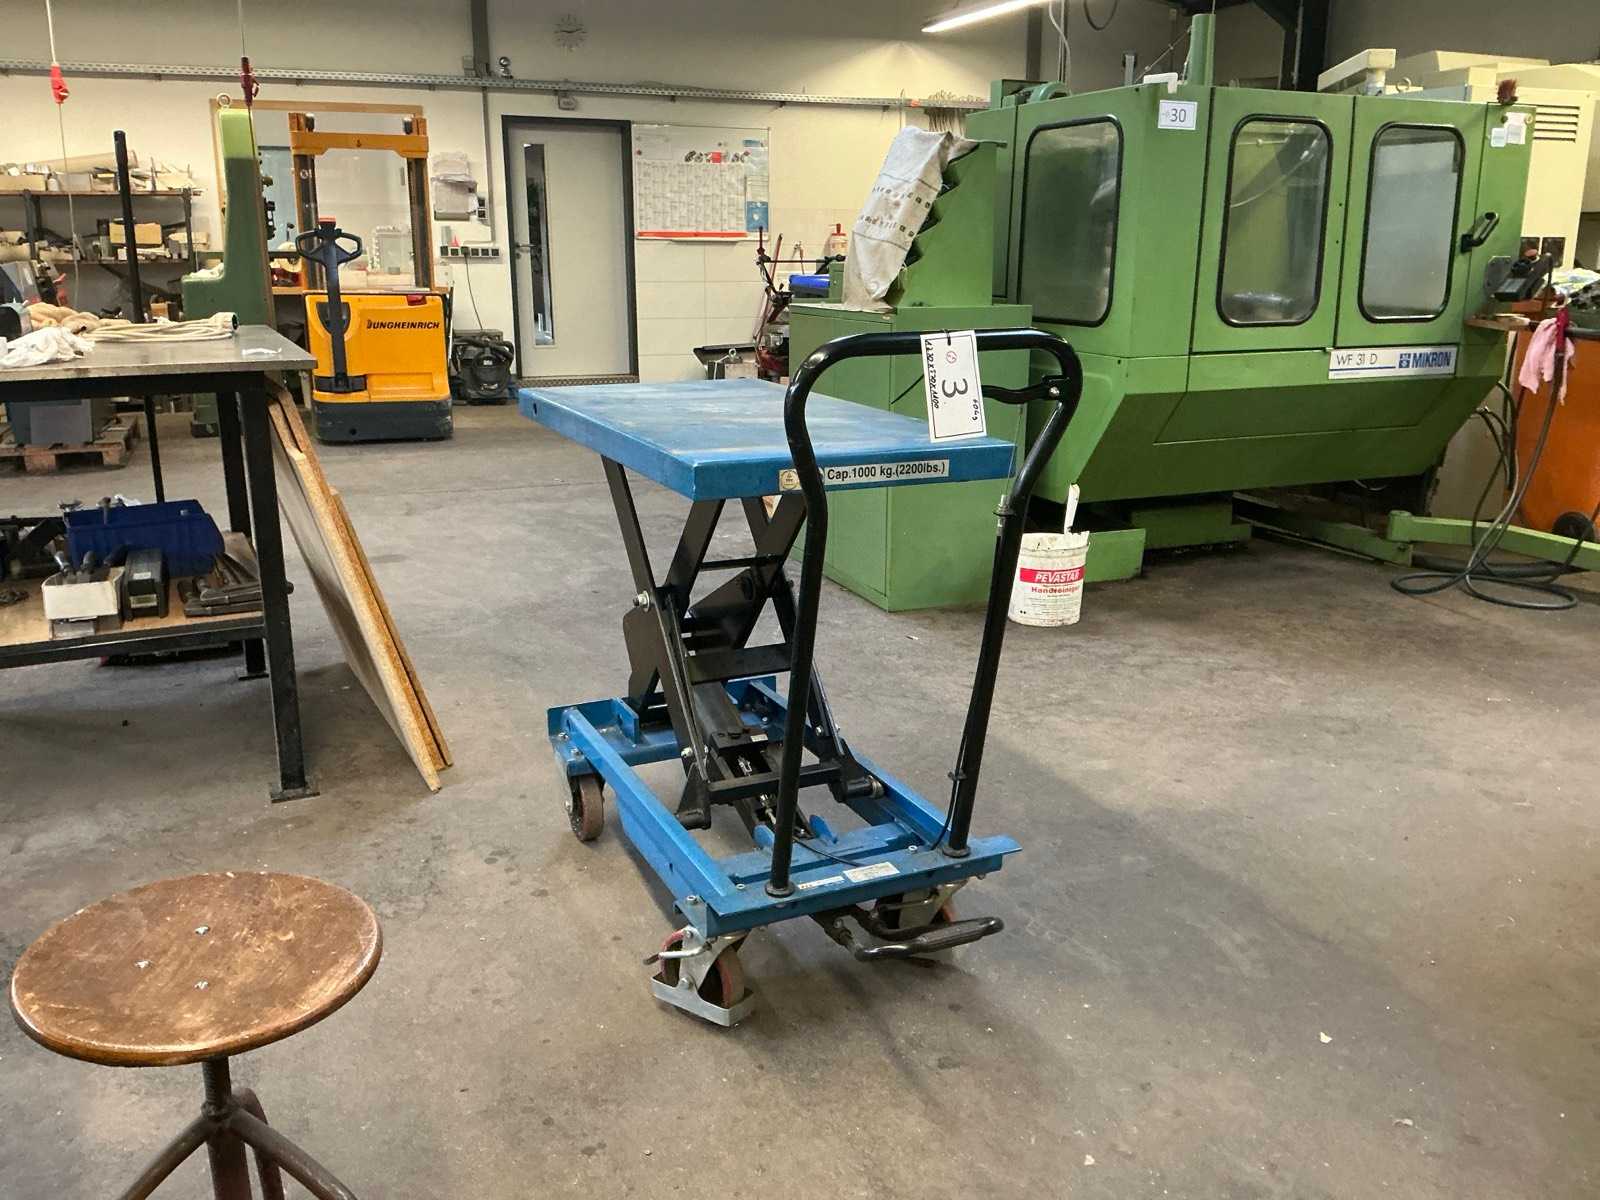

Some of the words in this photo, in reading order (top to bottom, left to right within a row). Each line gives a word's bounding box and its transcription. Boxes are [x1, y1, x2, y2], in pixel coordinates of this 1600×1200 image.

[1169, 108, 1187, 123] 30
[366, 319, 440, 330] JUNGHEINRICH
[1336, 354, 1353, 366] WF
[1369, 353, 1378, 365] D
[1411, 351, 1452, 369] MIKRON
[941, 378, 968, 398] 3
[827, 467, 877, 482] Cap.1000
[879, 461, 946, 479] kg.(2200lbs.)
[1034, 569, 1080, 583] PEVASTAR
